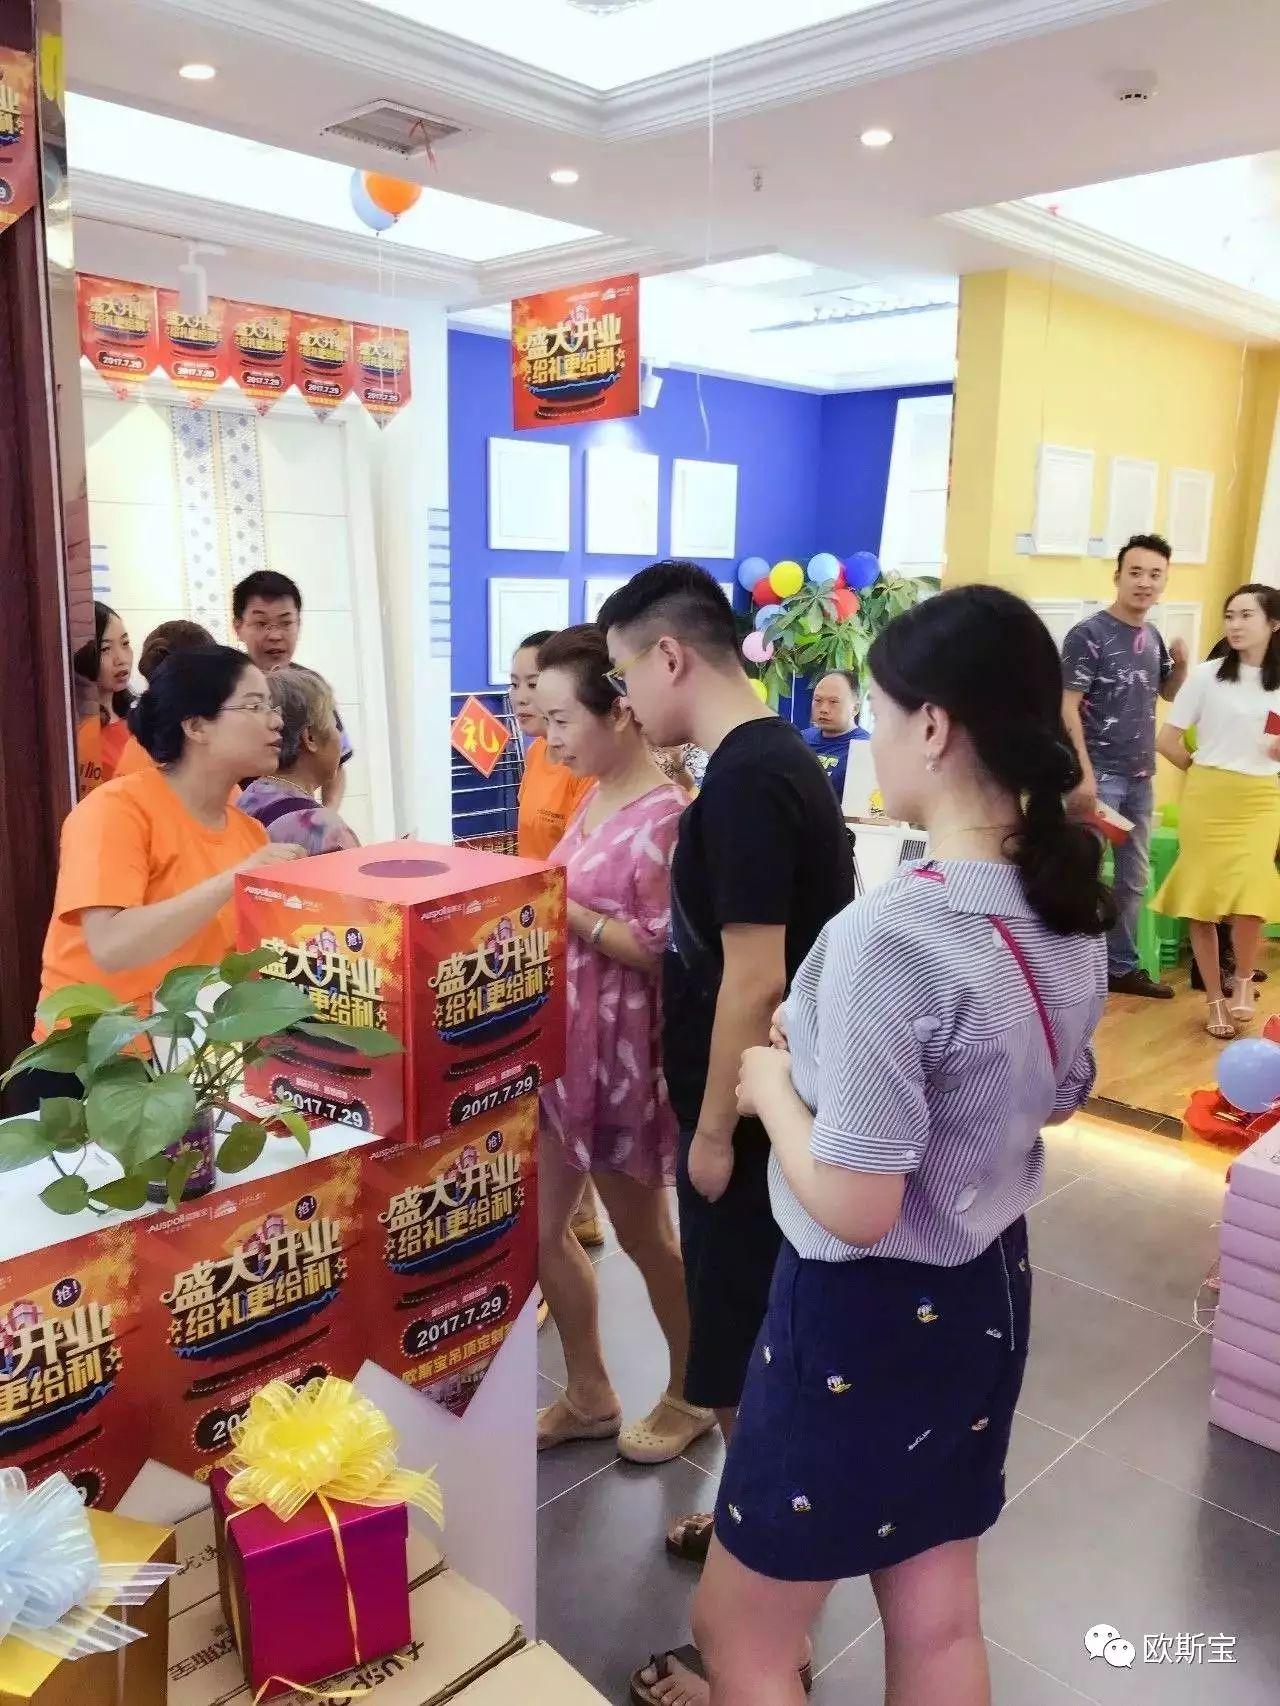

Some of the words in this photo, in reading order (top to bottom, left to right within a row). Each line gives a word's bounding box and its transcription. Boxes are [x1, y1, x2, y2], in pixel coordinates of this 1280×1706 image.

[518, 313, 622, 361] 盛大开业
[461, 717, 500, 753] 礼
[428, 927, 552, 1000] 盛大开业
[445, 966, 544, 1028] 给礼更给利
[461, 1076, 533, 1121] 2017.7.29
[378, 1150, 522, 1234] 盛大开业
[397, 1188, 513, 1260] 给礼更给利
[159, 1217, 343, 1314] 盛大开业
[185, 1259, 332, 1343] 给礼更给利
[0, 1301, 116, 1382] 开业
[417, 1296, 502, 1348] 2017.7.29
